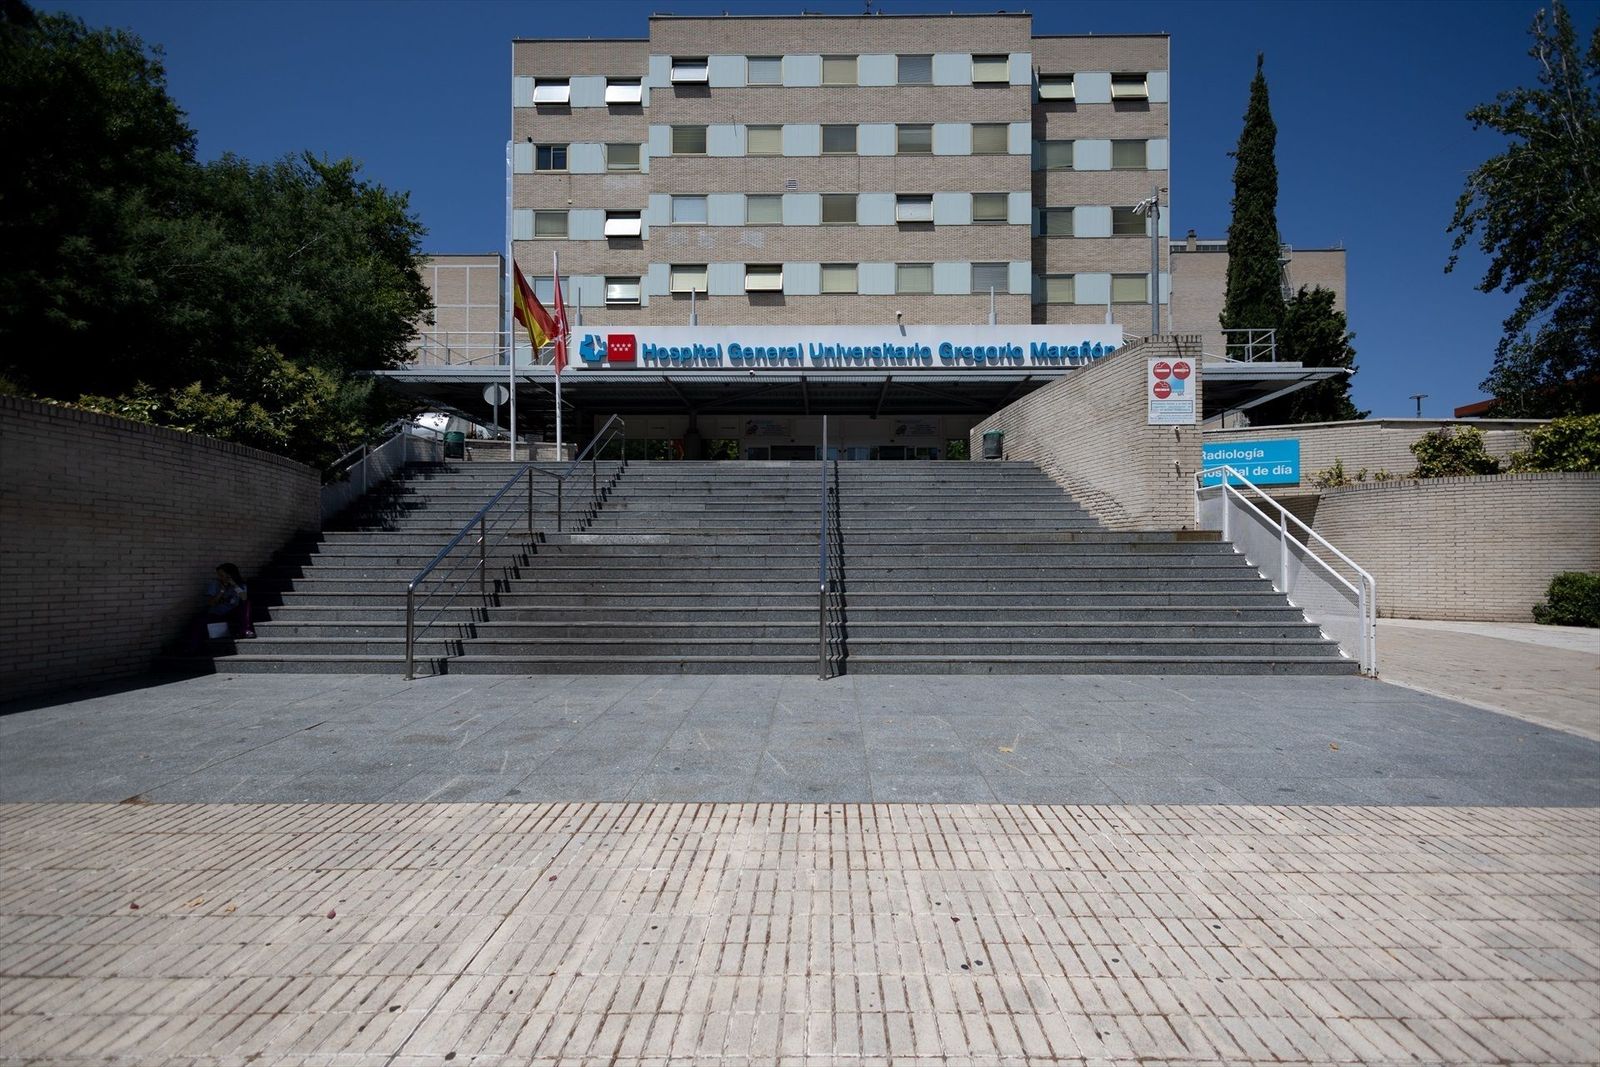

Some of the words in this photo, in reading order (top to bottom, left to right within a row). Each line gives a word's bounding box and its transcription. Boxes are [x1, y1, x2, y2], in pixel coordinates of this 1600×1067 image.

[641, 342, 723, 364] Hospital
[727, 342, 802, 361] General
[809, 342, 932, 361] Universitario
[938, 341, 1024, 362] Gregorio
[1030, 340, 1116, 360] Marañón
[1252, 466, 1269, 476] de
[1272, 465, 1292, 475] día
